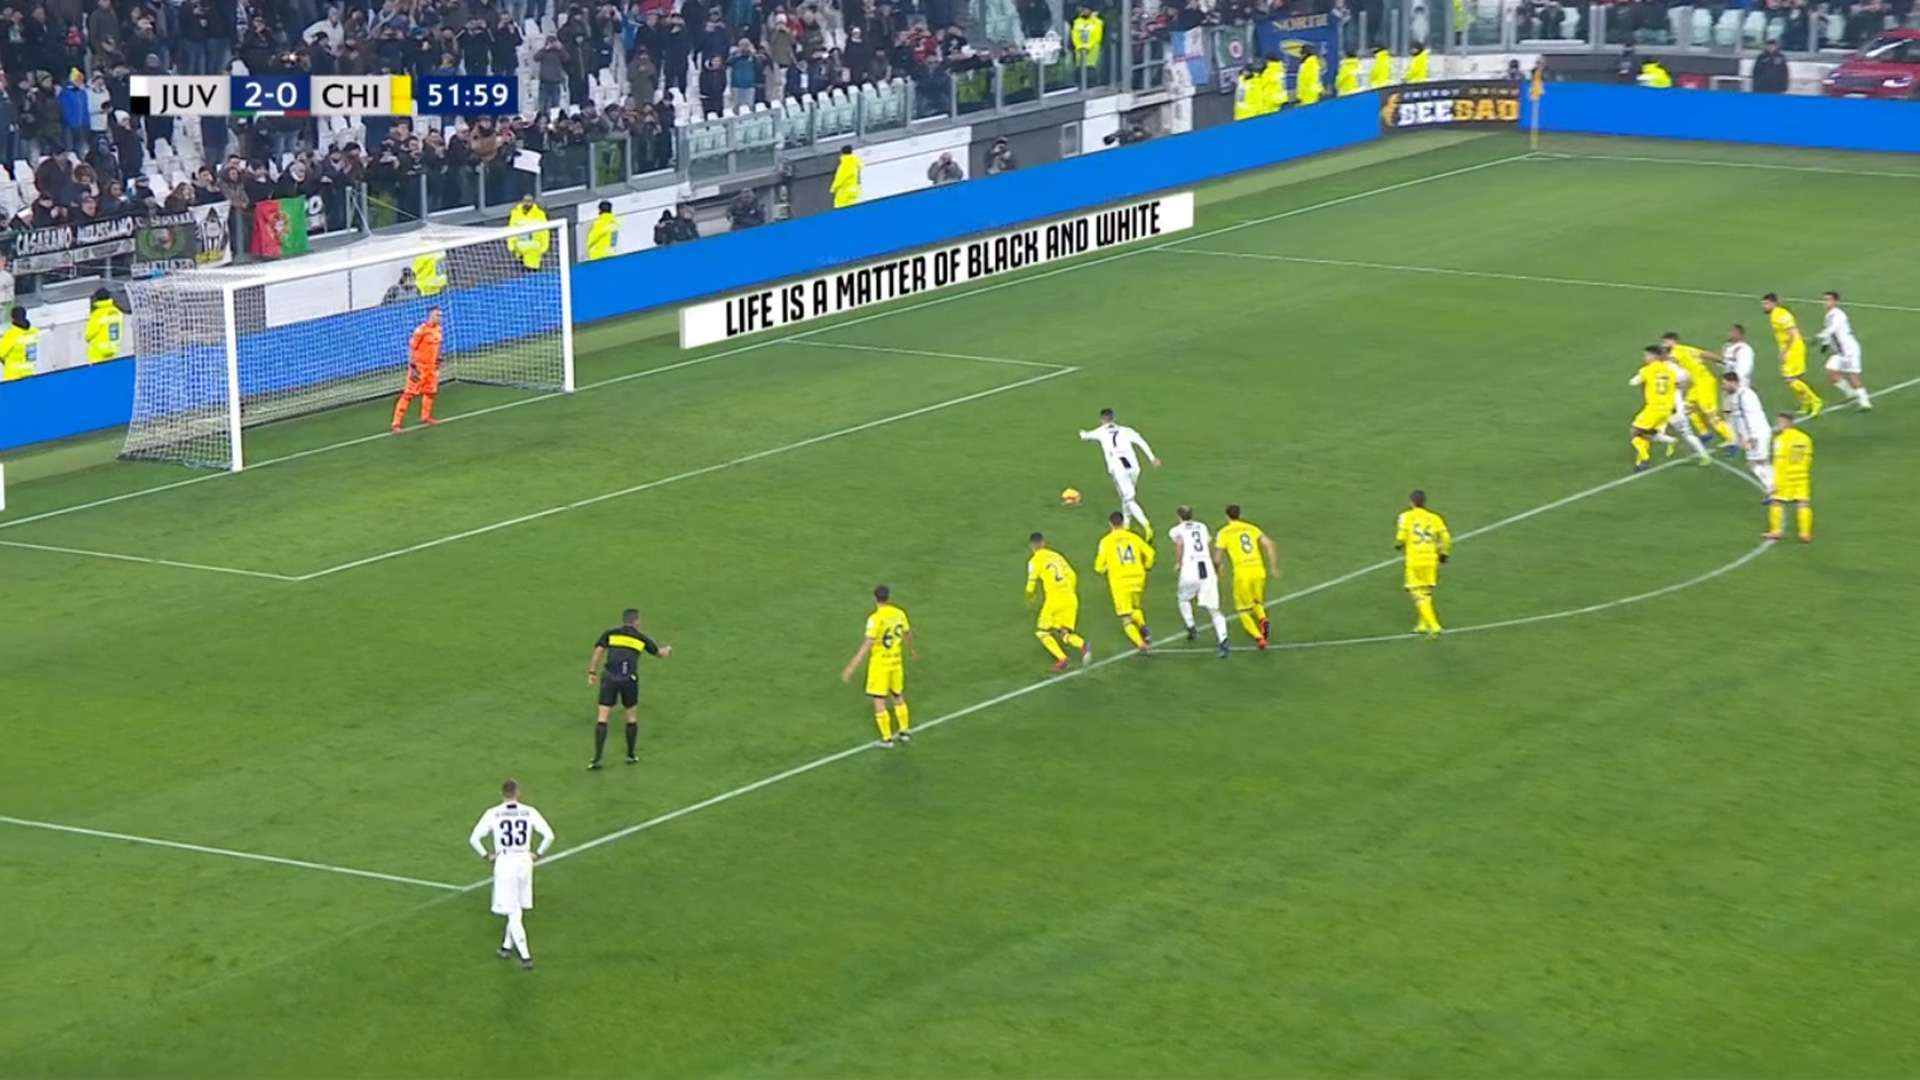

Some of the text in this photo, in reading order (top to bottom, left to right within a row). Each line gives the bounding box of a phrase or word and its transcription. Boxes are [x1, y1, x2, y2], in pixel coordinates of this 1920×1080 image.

[726, 200, 1161, 338] LIFE IS A MATTER OF BLACK AND WHITE
[1108, 430, 1119, 448] 7
[1191, 530, 1204, 552] 3
[1239, 532, 1255, 555] 8
[1115, 543, 1136, 565] 14
[499, 818, 529, 848] 33
